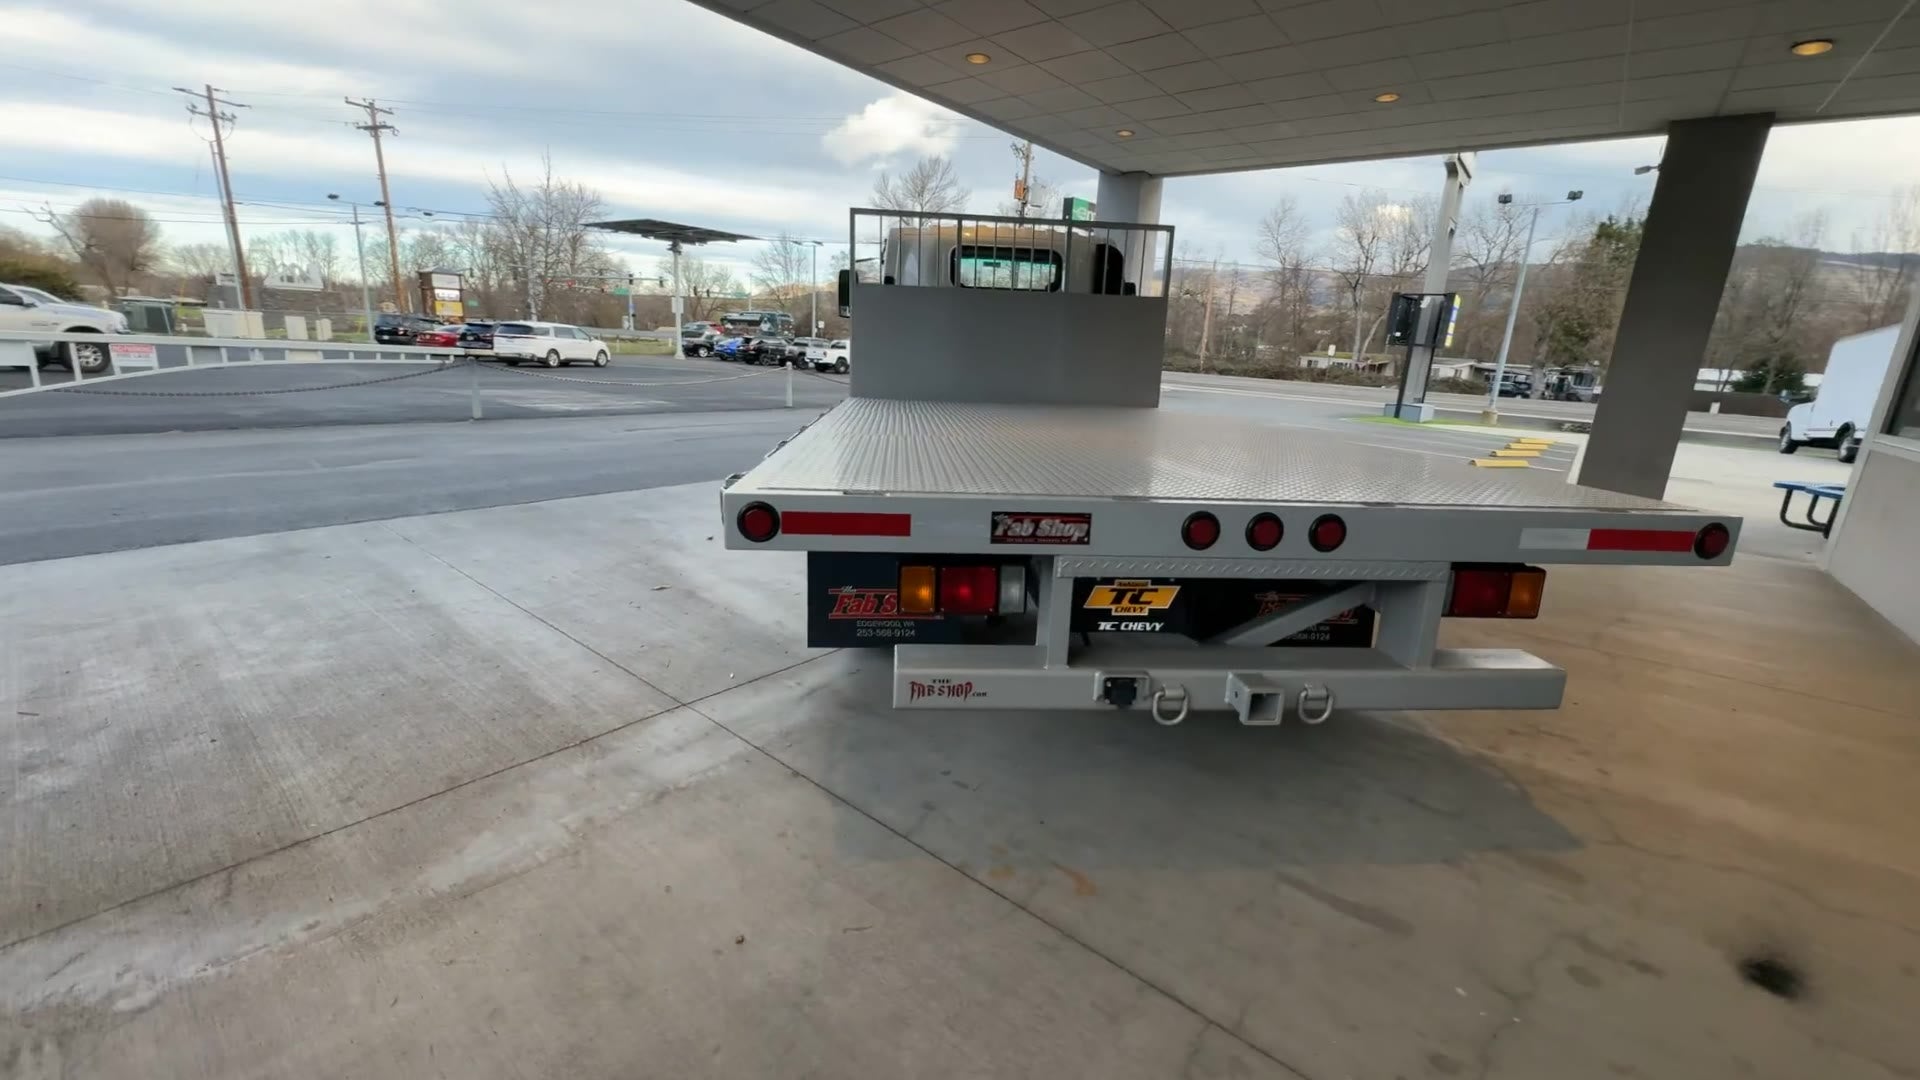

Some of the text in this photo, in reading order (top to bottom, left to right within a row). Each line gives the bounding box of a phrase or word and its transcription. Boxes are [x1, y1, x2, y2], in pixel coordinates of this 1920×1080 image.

[994, 518, 1089, 541] Fab Shop
[833, 593, 878, 615] Fab
[1108, 588, 1159, 605] TC
[856, 629, 916, 637] 253-568-9124
[1097, 621, 1164, 631] TC CHEVY
